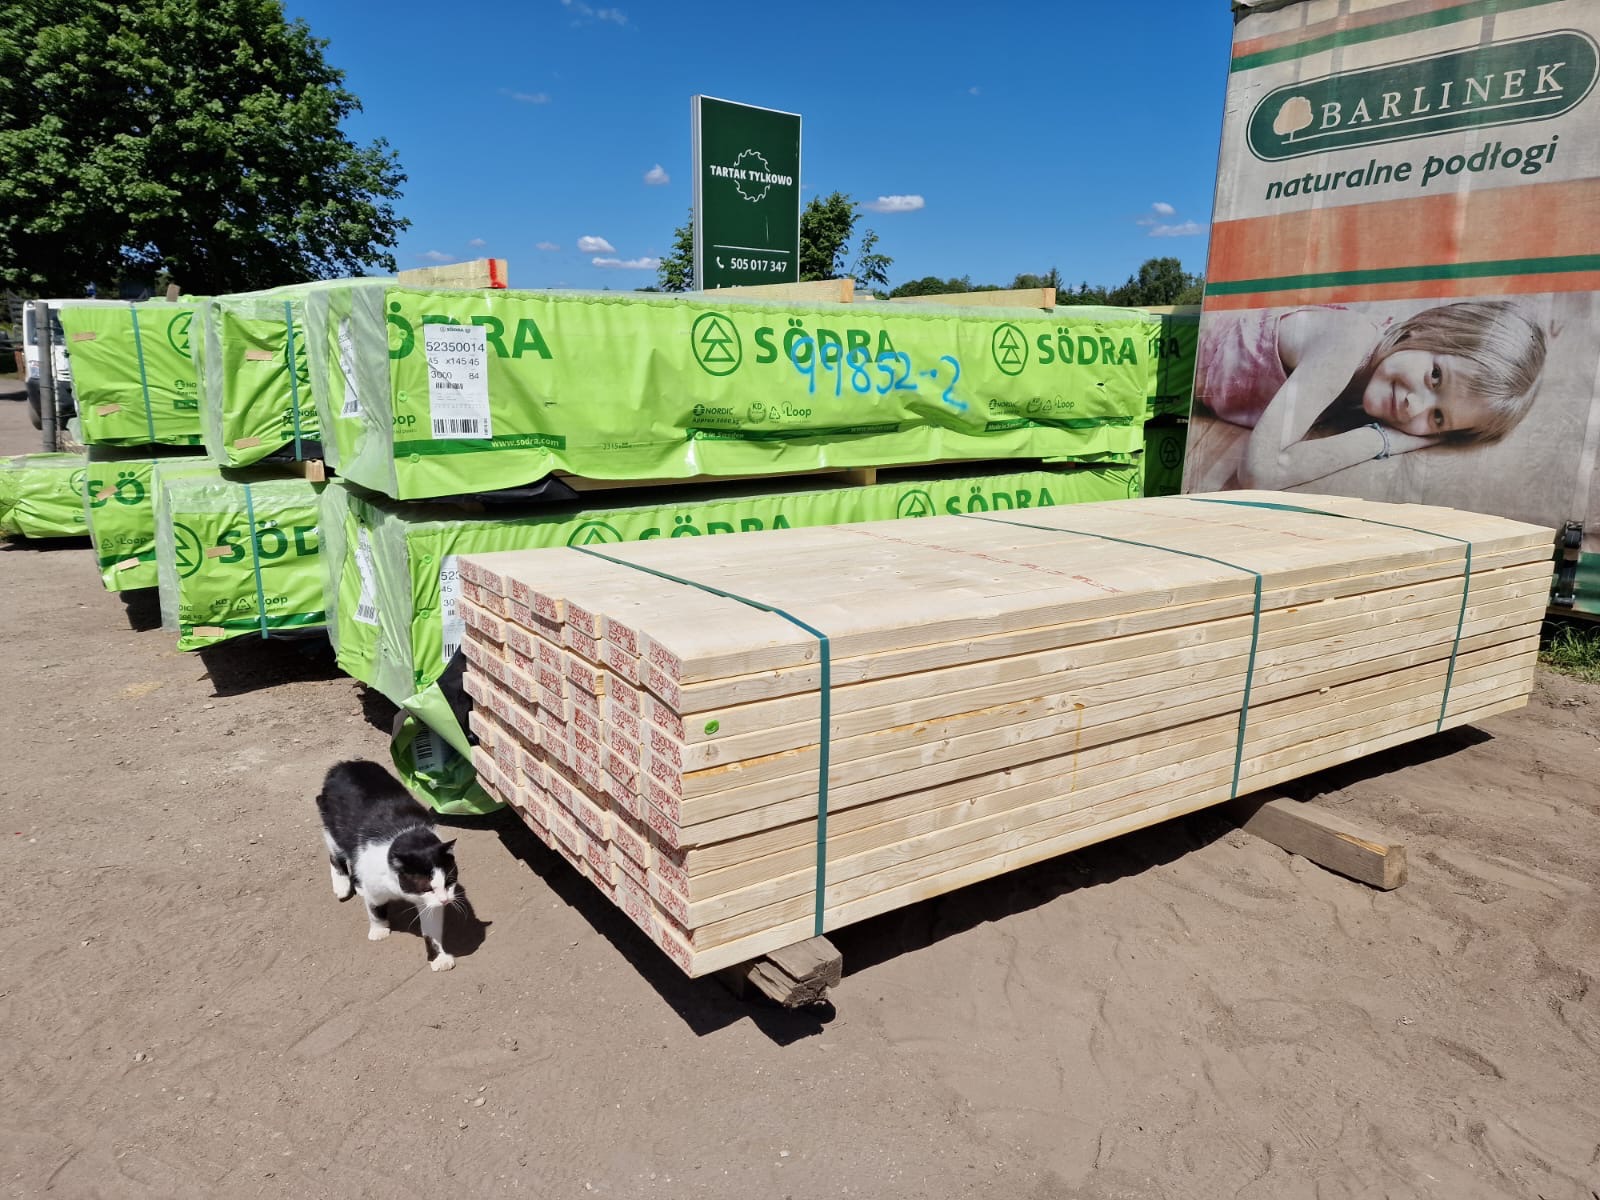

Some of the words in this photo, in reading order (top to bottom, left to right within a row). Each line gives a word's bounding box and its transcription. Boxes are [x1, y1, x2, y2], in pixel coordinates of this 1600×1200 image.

[1319, 62, 1566, 130] BARLINEK
[1265, 159, 1413, 200] naturalne
[1421, 135, 1560, 187] podłogi
[710, 165, 747, 180] TARTAK
[749, 171, 792, 186] TYLKOWO
[731, 258, 749, 270] 505
[751, 260, 768, 271] 017
[770, 262, 787, 273] 347
[426, 341, 485, 353] 52350014
[754, 318, 901, 364] SÖDRA
[1036, 326, 1138, 366] SÖDRA
[469, 358, 480, 366] 45
[752, 402, 763, 410] KD
[1057, 400, 1074, 409] Loop
[705, 407, 734, 416] NORDIC
[786, 406, 812, 417] Loop
[491, 437, 559, 448] www.sodra.com
